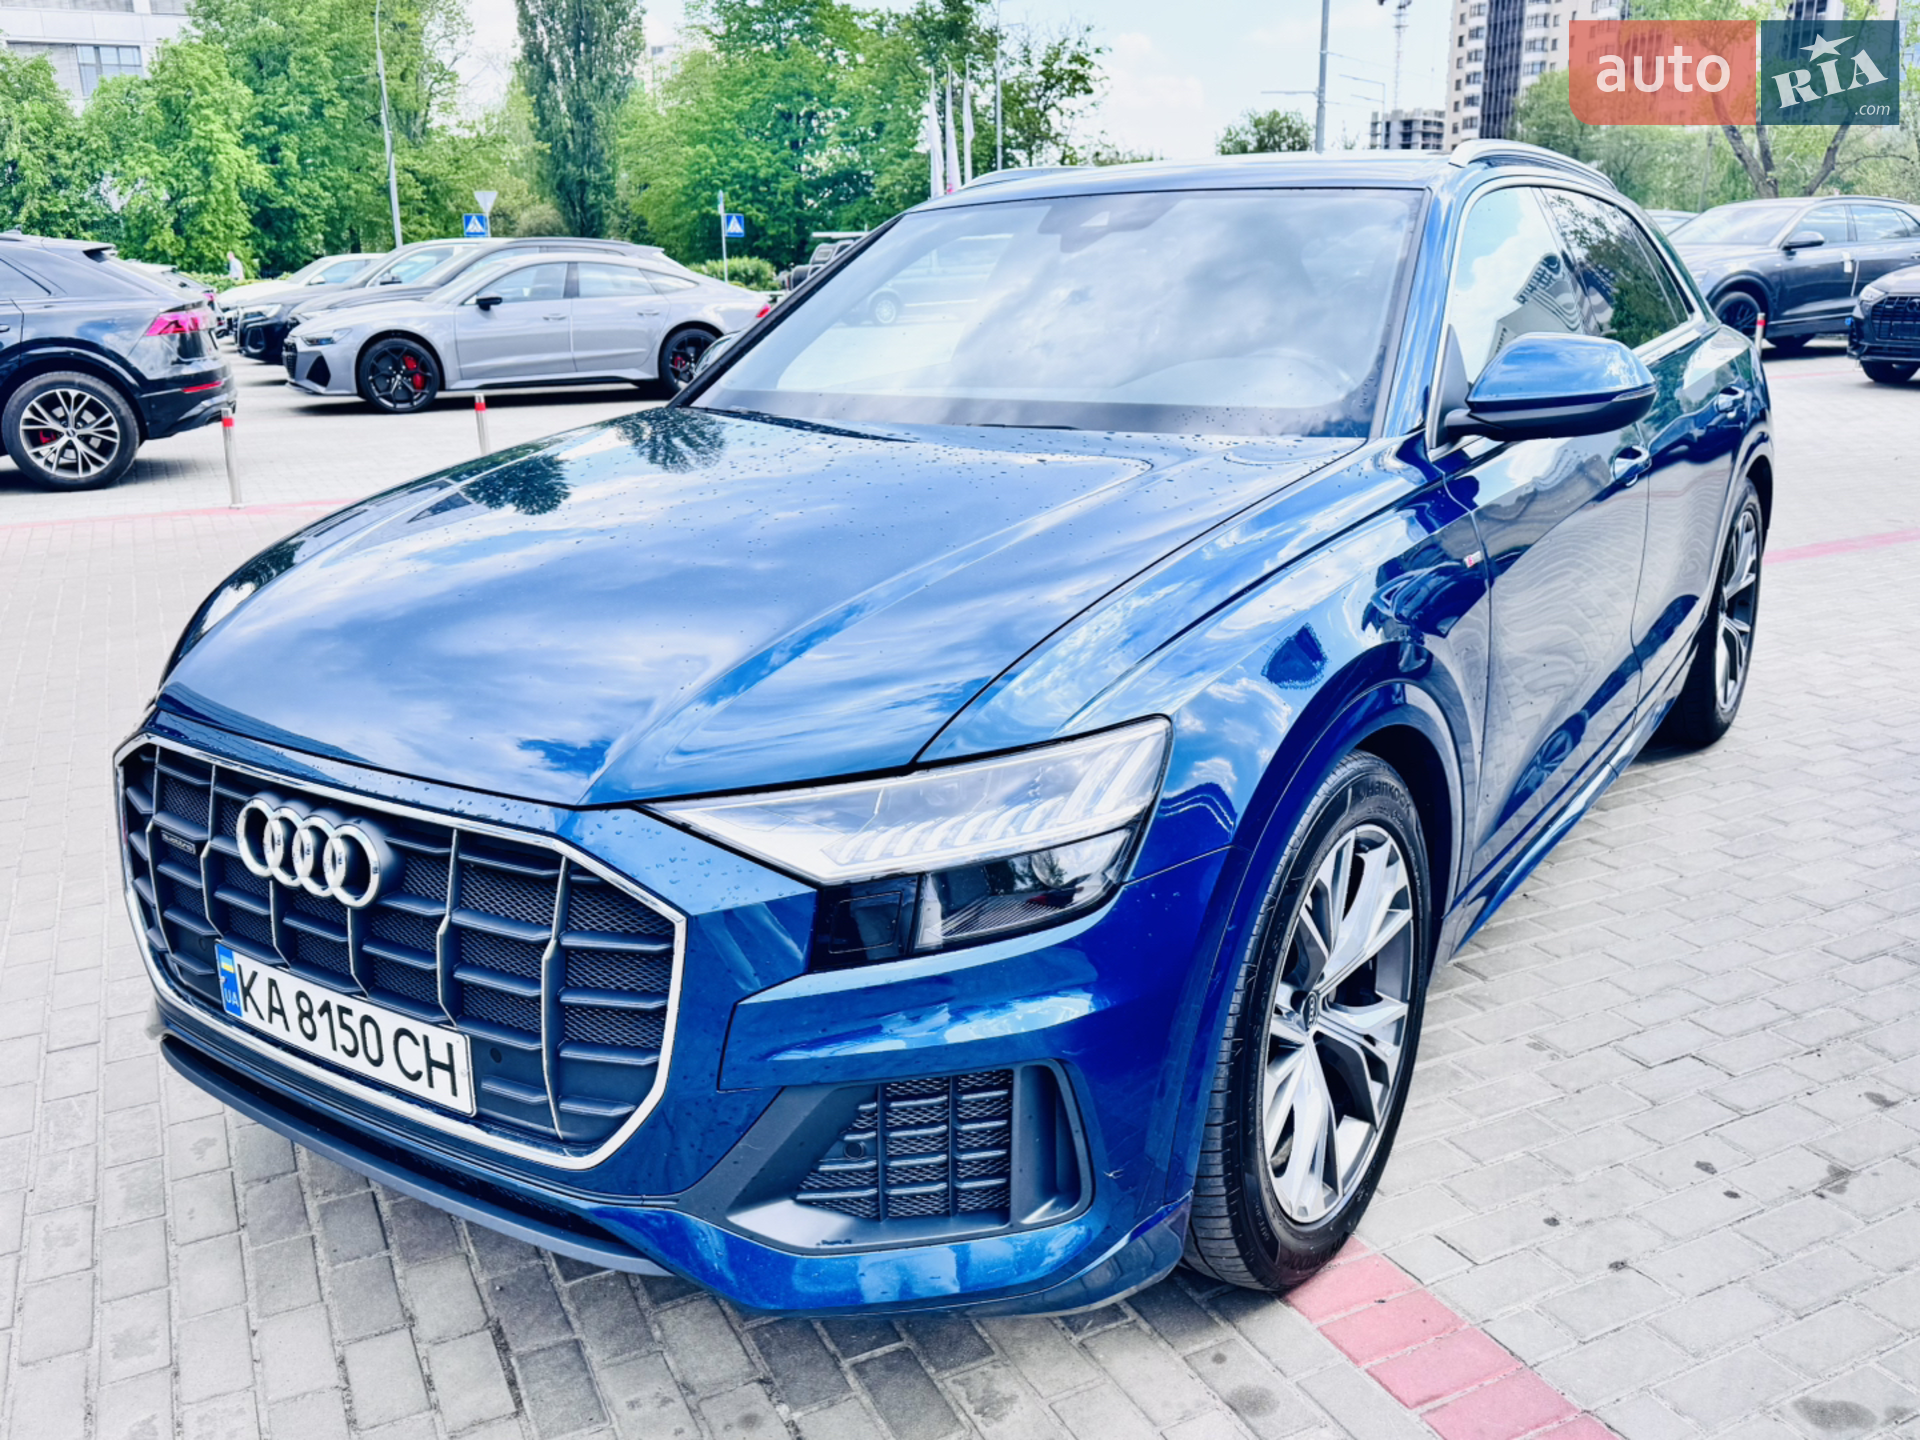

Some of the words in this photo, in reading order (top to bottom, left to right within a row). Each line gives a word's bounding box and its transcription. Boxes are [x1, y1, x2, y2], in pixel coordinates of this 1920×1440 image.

[223, 987, 240, 1008] UA
[237, 963, 290, 1033] KA
[294, 990, 384, 1068] 8150
[393, 1027, 458, 1098] CH
